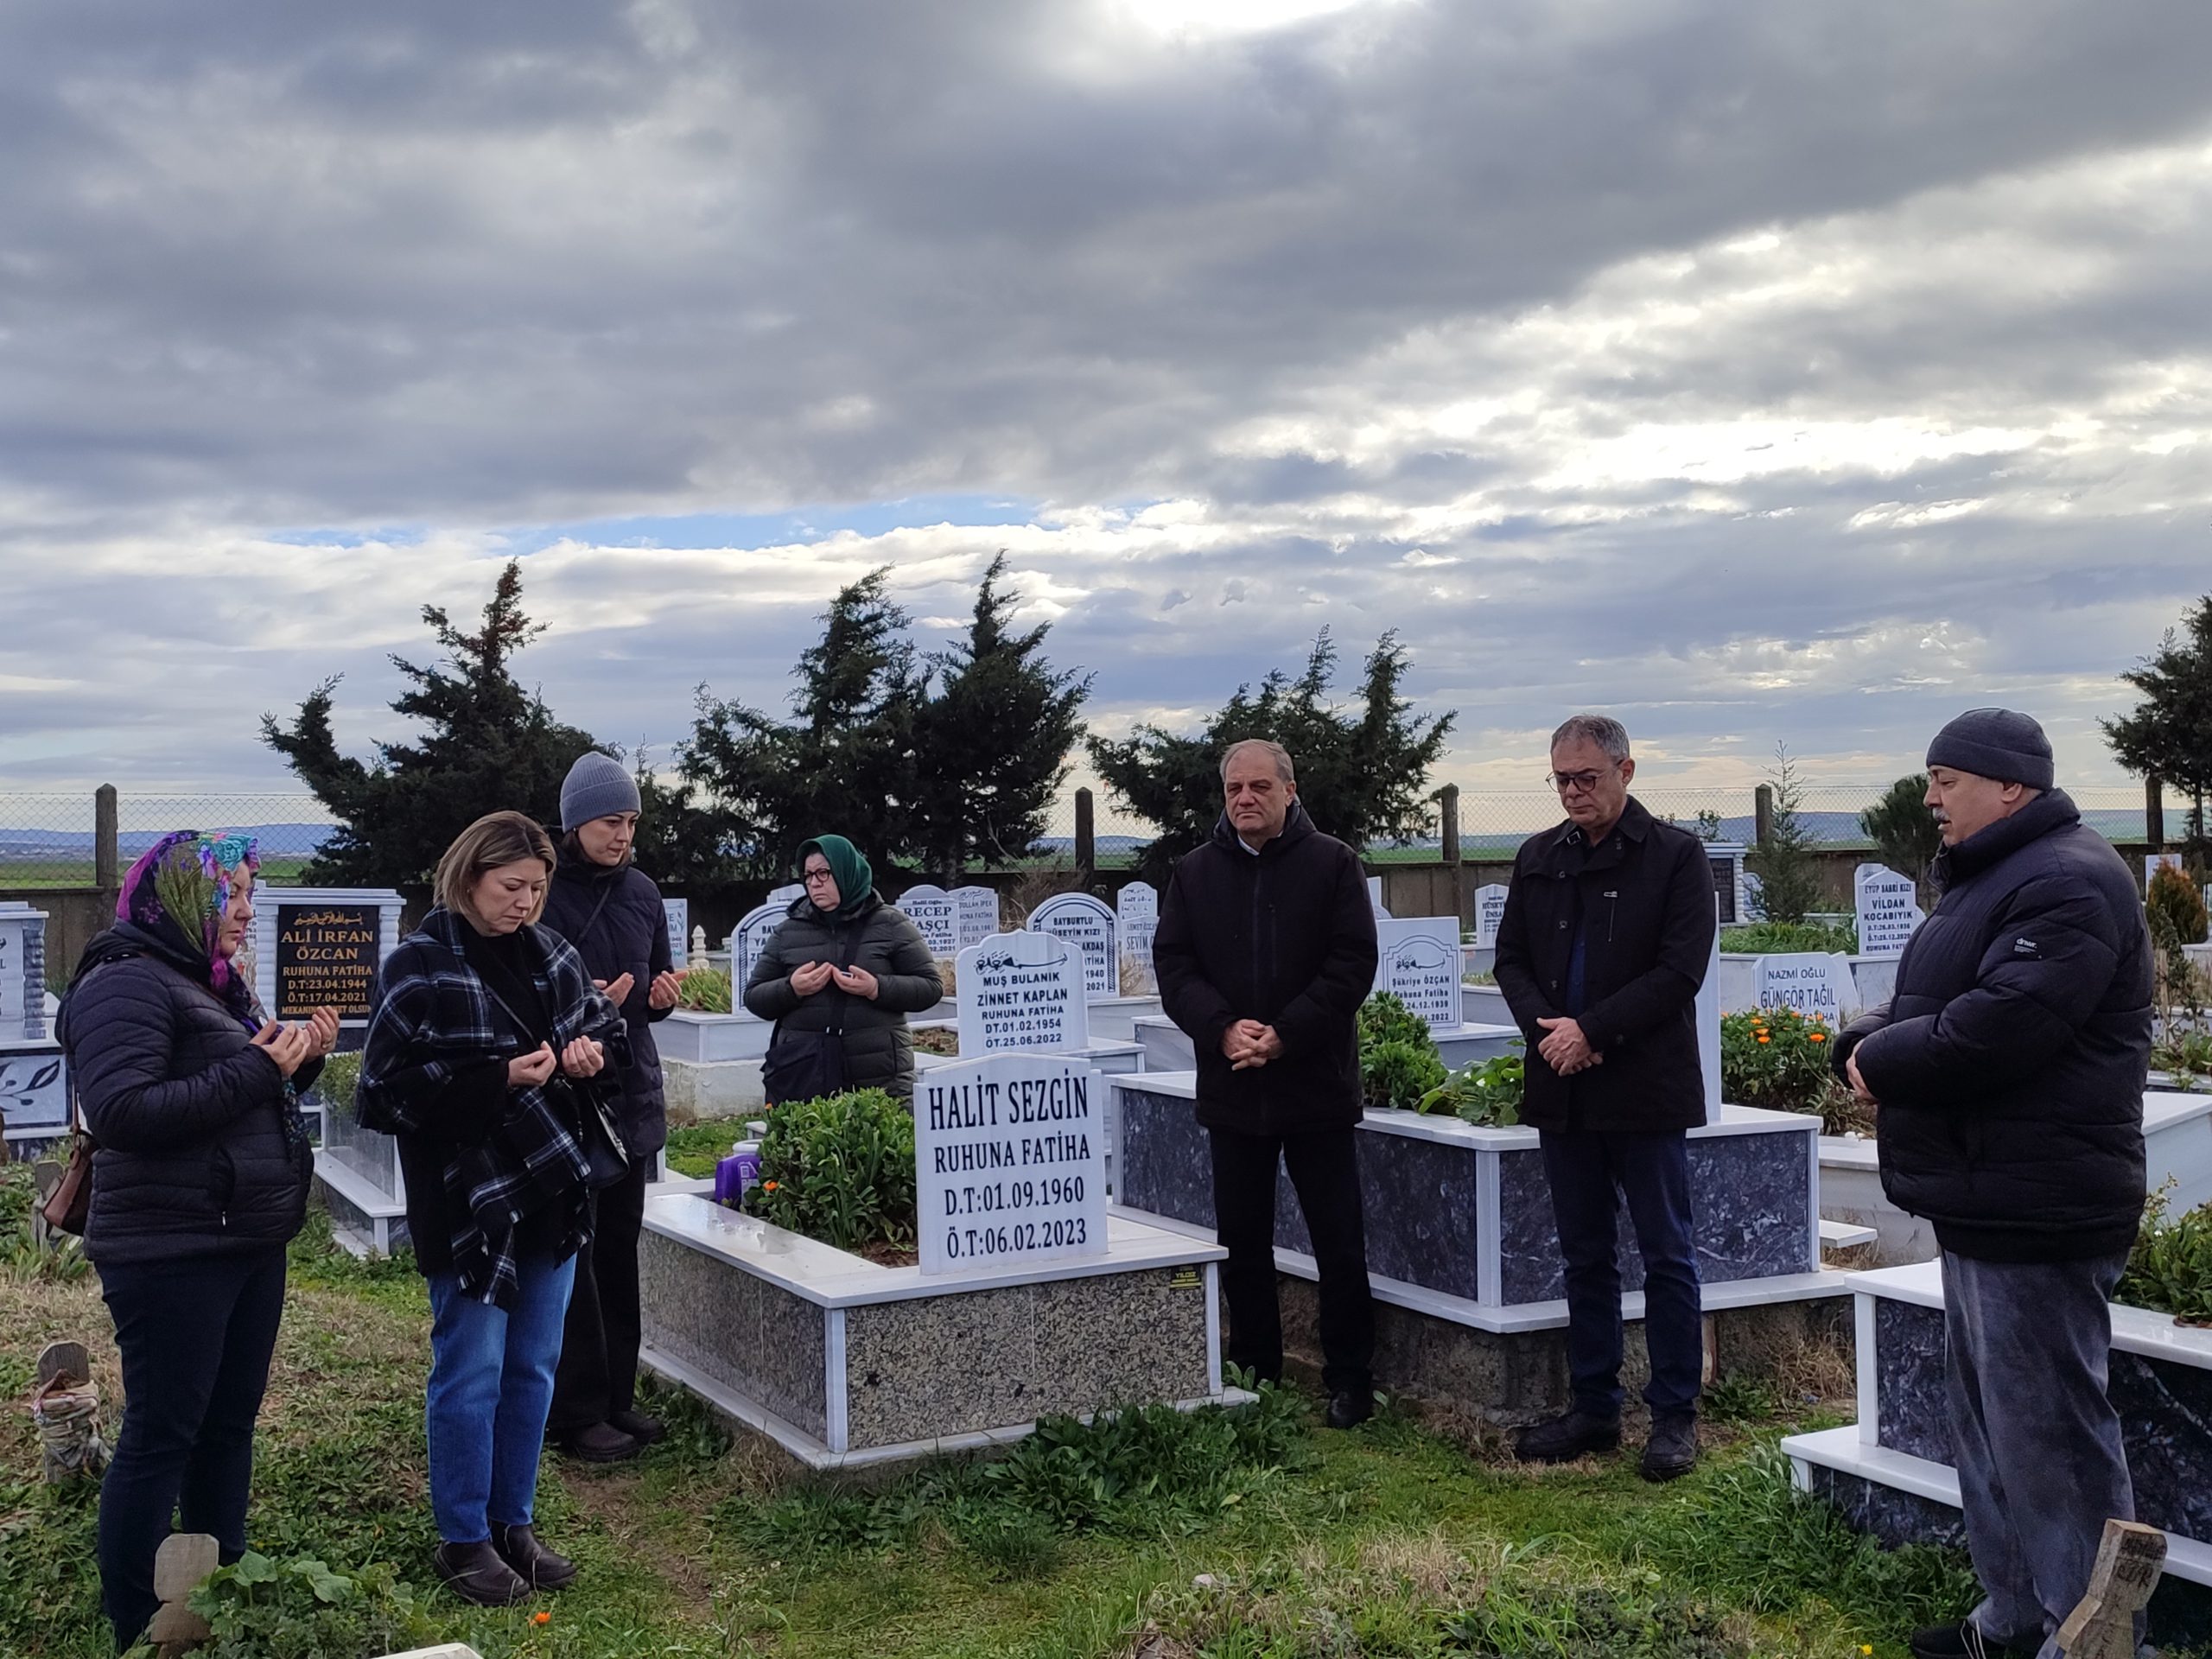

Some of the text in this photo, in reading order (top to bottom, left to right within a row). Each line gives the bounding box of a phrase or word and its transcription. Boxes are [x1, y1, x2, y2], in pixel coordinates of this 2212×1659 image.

[1872, 897, 1905, 909] VİLDAN
[904, 906, 952, 917] RECEP
[1864, 912, 1913, 921] KOCABIYIK
[912, 919, 950, 932] AŞÇI
[1053, 916, 1093, 926] BAYBURTLU
[281, 928, 373, 943] ALİ İRFAN
[296, 945, 359, 961] ÖZCAN
[1082, 941, 1104, 954] AKDAŞ
[1084, 955, 1105, 966] TİHA
[283, 964, 372, 976] RUHUNA FATİHA
[1768, 967, 1826, 980] NAZMİ OĞLU
[288, 979, 366, 990] D.T:23.04.1944
[983, 971, 1060, 988] MUŞ BULANIK
[287, 992, 366, 1003] Ö.T:17.04.2021
[977, 988, 1068, 1007] ZİNNET KAPLAN
[1425, 988, 1449, 998] Fatiha
[1760, 983, 1835, 1009] GÜNGÖR TAĞIL
[982, 1004, 1064, 1020] RUHUNA FATİHA
[985, 1018, 1061, 1034] DT.01.02.1954
[985, 1033, 1062, 1048] ÖT.25.06.2022
[928, 1068, 1088, 1130] HALİT SEZGİN
[934, 1130, 1090, 1173] RUHUNA FATİHA
[944, 1176, 1084, 1216] D.T:01.09.1960
[947, 1217, 1087, 1258] Ö.T:06.02.2023
